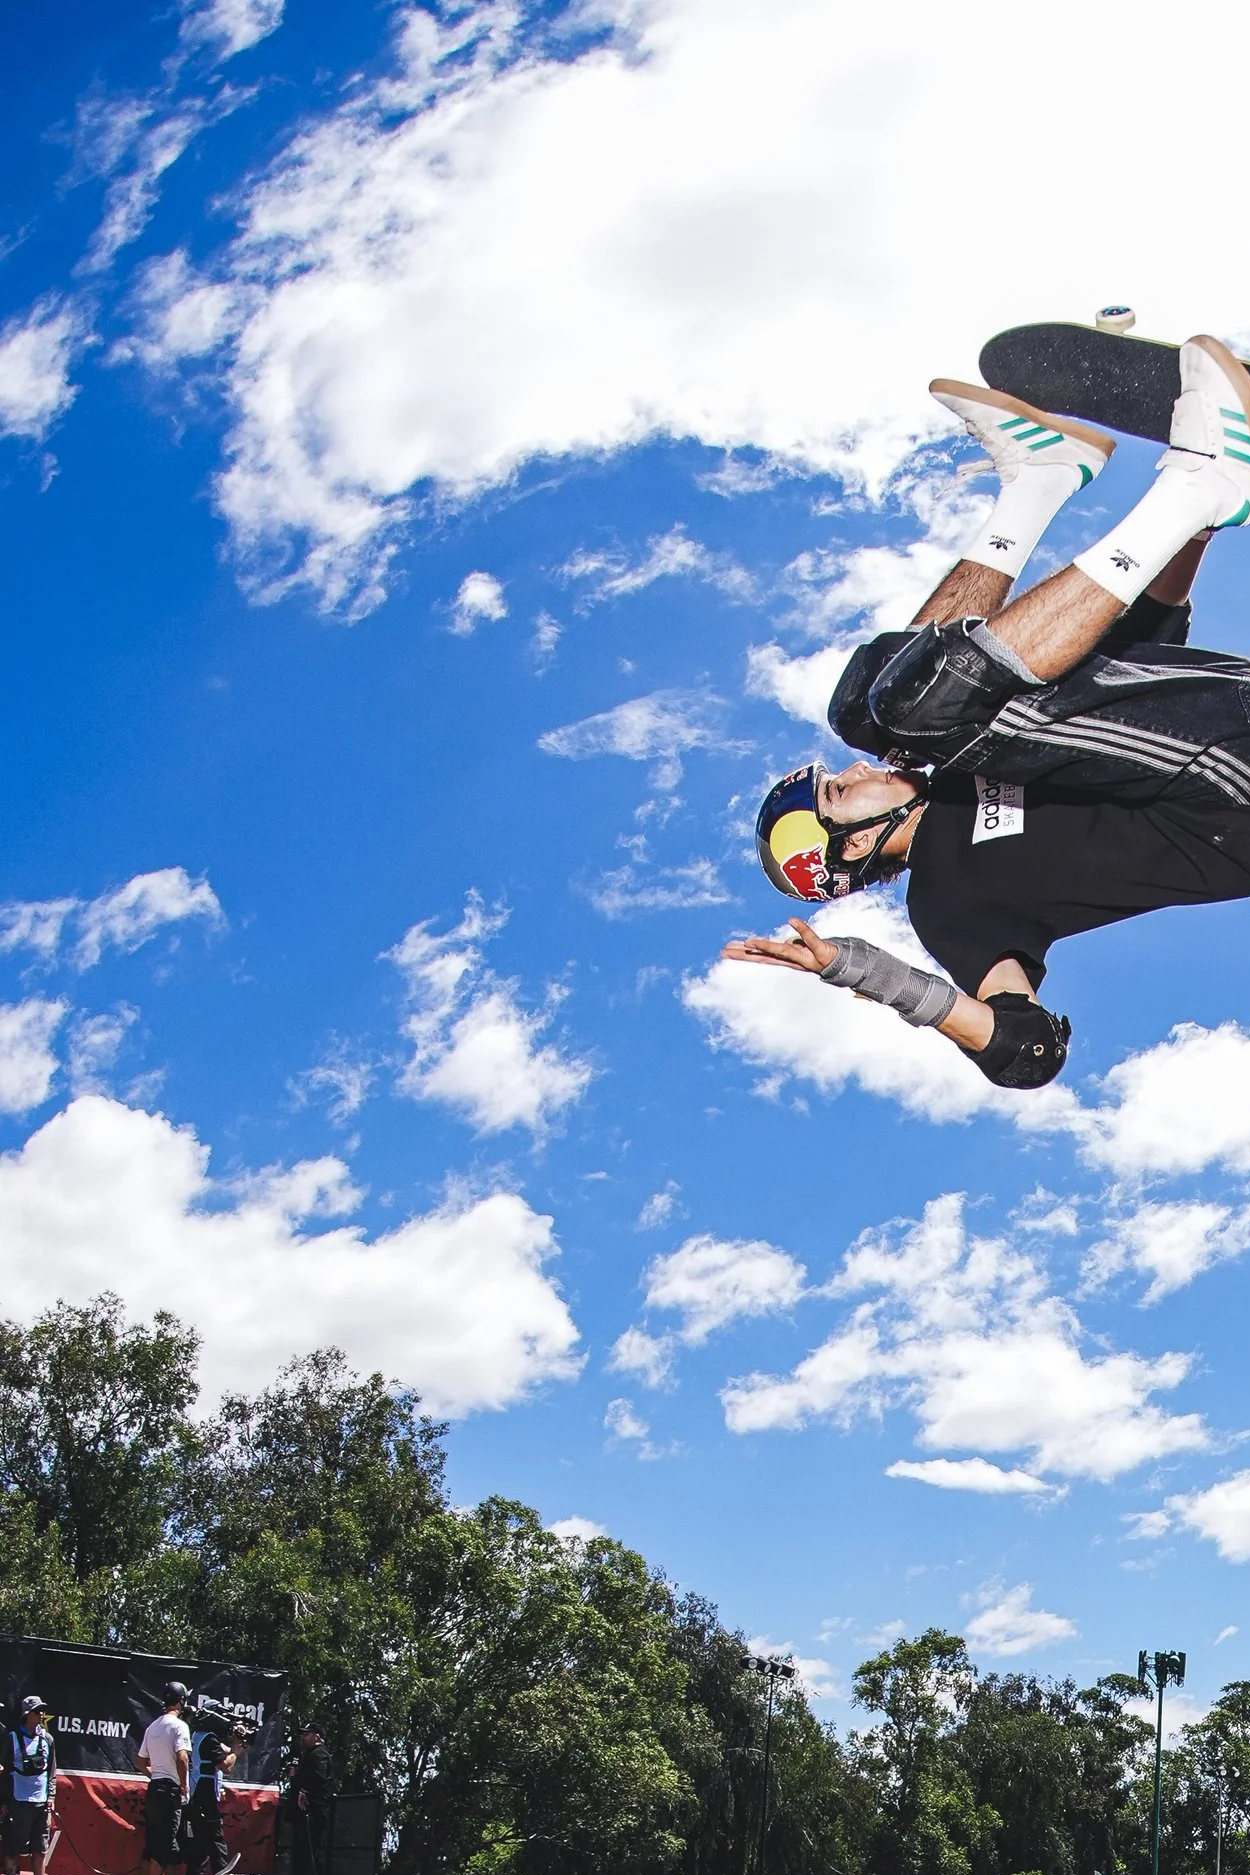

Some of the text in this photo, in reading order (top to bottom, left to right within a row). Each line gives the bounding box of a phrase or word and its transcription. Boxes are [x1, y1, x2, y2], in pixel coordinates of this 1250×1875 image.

[1115, 549, 1141, 568] adidas
[197, 1694, 265, 1727] Bbcat
[57, 1715, 131, 1739] U.S. ARMY
